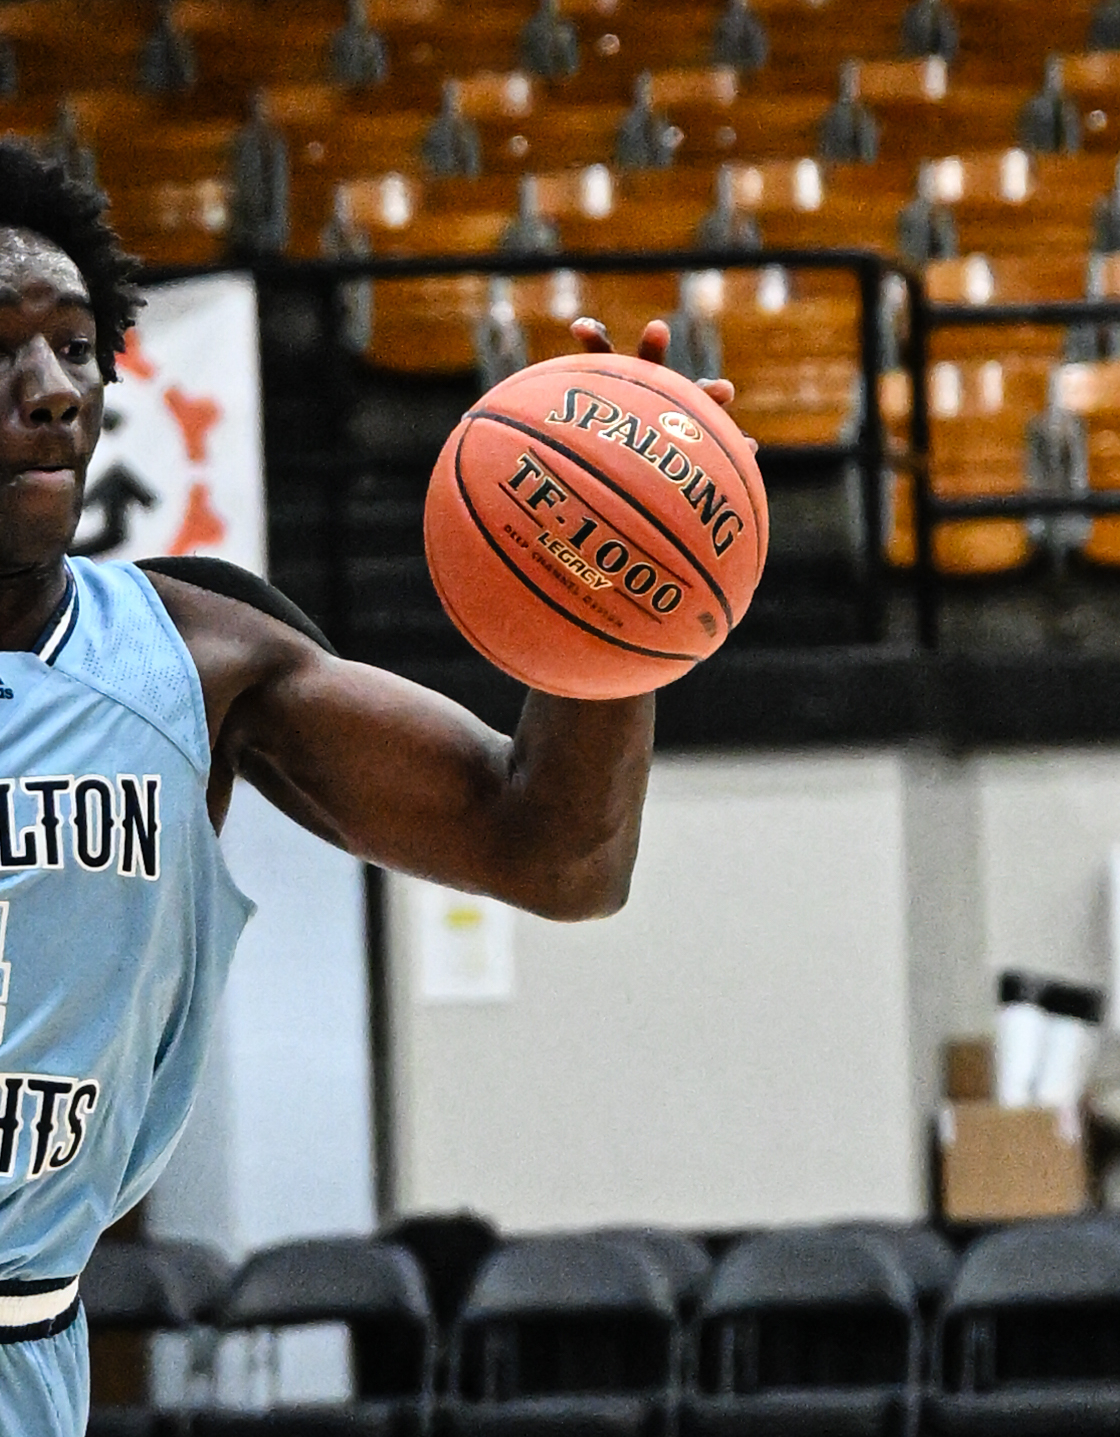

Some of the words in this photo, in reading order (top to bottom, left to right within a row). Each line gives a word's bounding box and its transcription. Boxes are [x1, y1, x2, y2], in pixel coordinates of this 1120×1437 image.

[507, 452, 684, 615] TF-1000
[545, 387, 744, 559] SPALDING
[537, 530, 613, 590] LEGACY
